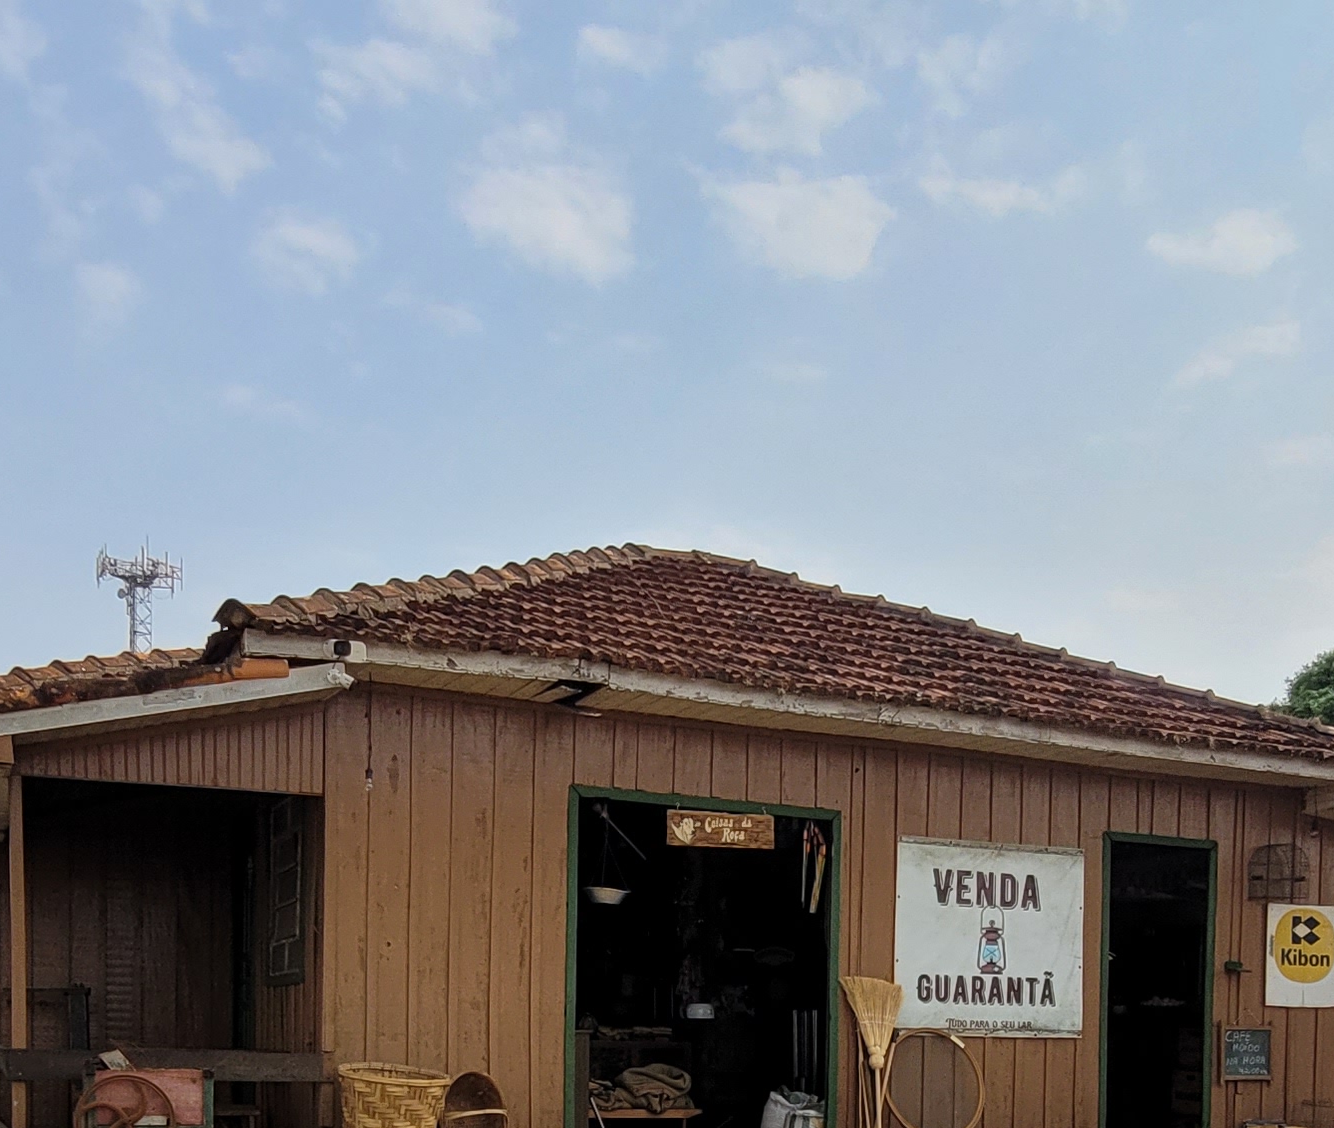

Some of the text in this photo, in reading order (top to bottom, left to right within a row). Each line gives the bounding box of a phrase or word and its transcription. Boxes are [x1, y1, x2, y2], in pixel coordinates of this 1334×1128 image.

[741, 817, 752, 828] da
[933, 868, 1041, 912] VENDA
[1280, 948, 1331, 968] Kibon
[916, 971, 1056, 1007] GUARANTÃ
[969, 1020, 990, 1028] PARA
[992, 1020, 999, 1028] O
[1000, 1021, 1016, 1029] SEU
[1017, 1021, 1033, 1029] LAR
[1242, 1055, 1266, 1065] HORA
